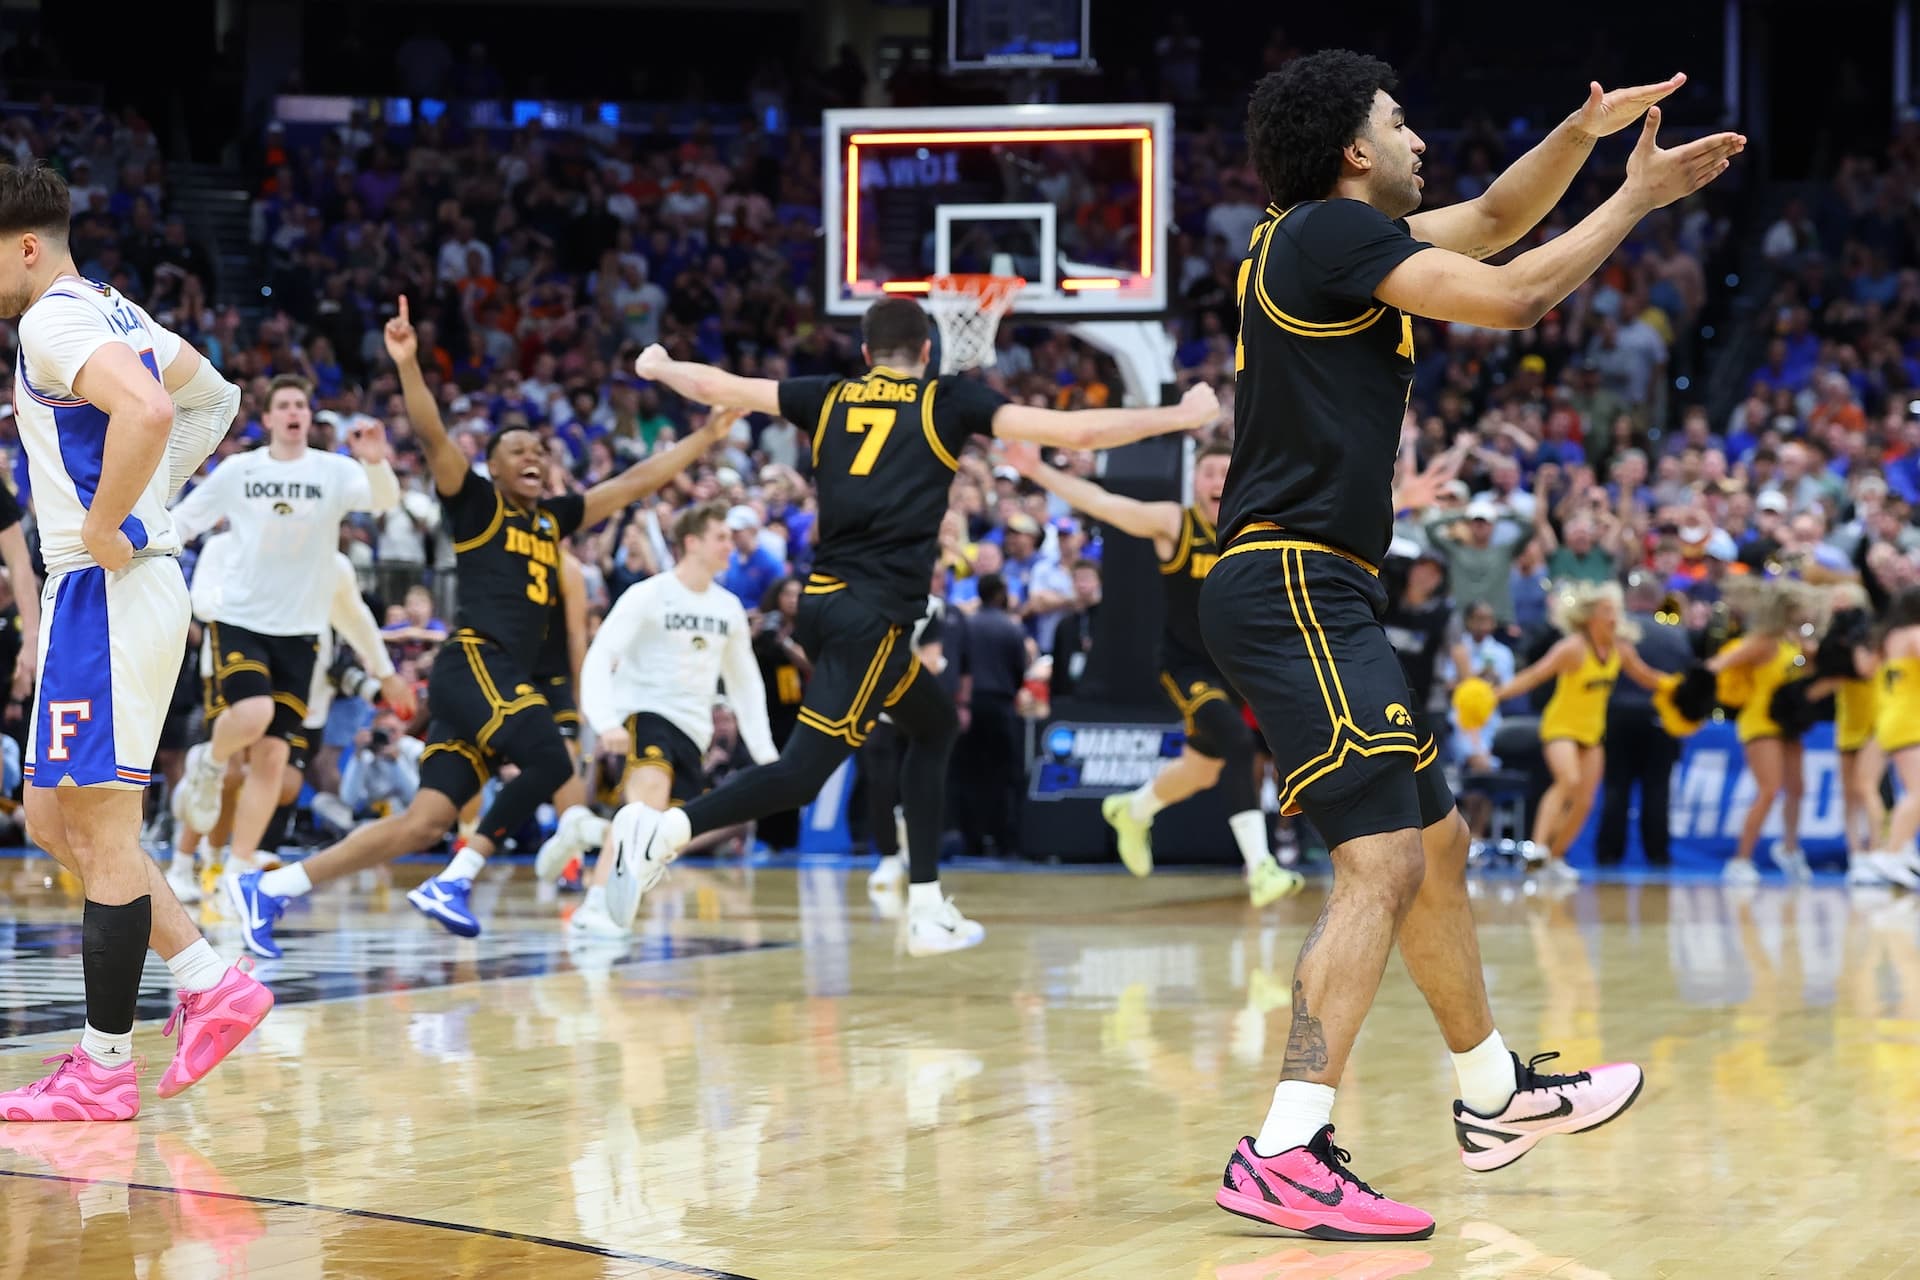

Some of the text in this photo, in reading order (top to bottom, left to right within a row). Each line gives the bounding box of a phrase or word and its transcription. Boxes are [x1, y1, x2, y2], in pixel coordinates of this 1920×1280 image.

[846, 407, 897, 475] 7
[245, 482, 322, 499] LOCK IT IN
[504, 526, 558, 568] IOWA
[526, 560, 549, 606] 3
[665, 614, 698, 630] LOCK
[47, 700, 92, 761] F
[1074, 729, 1162, 757] MARCH
